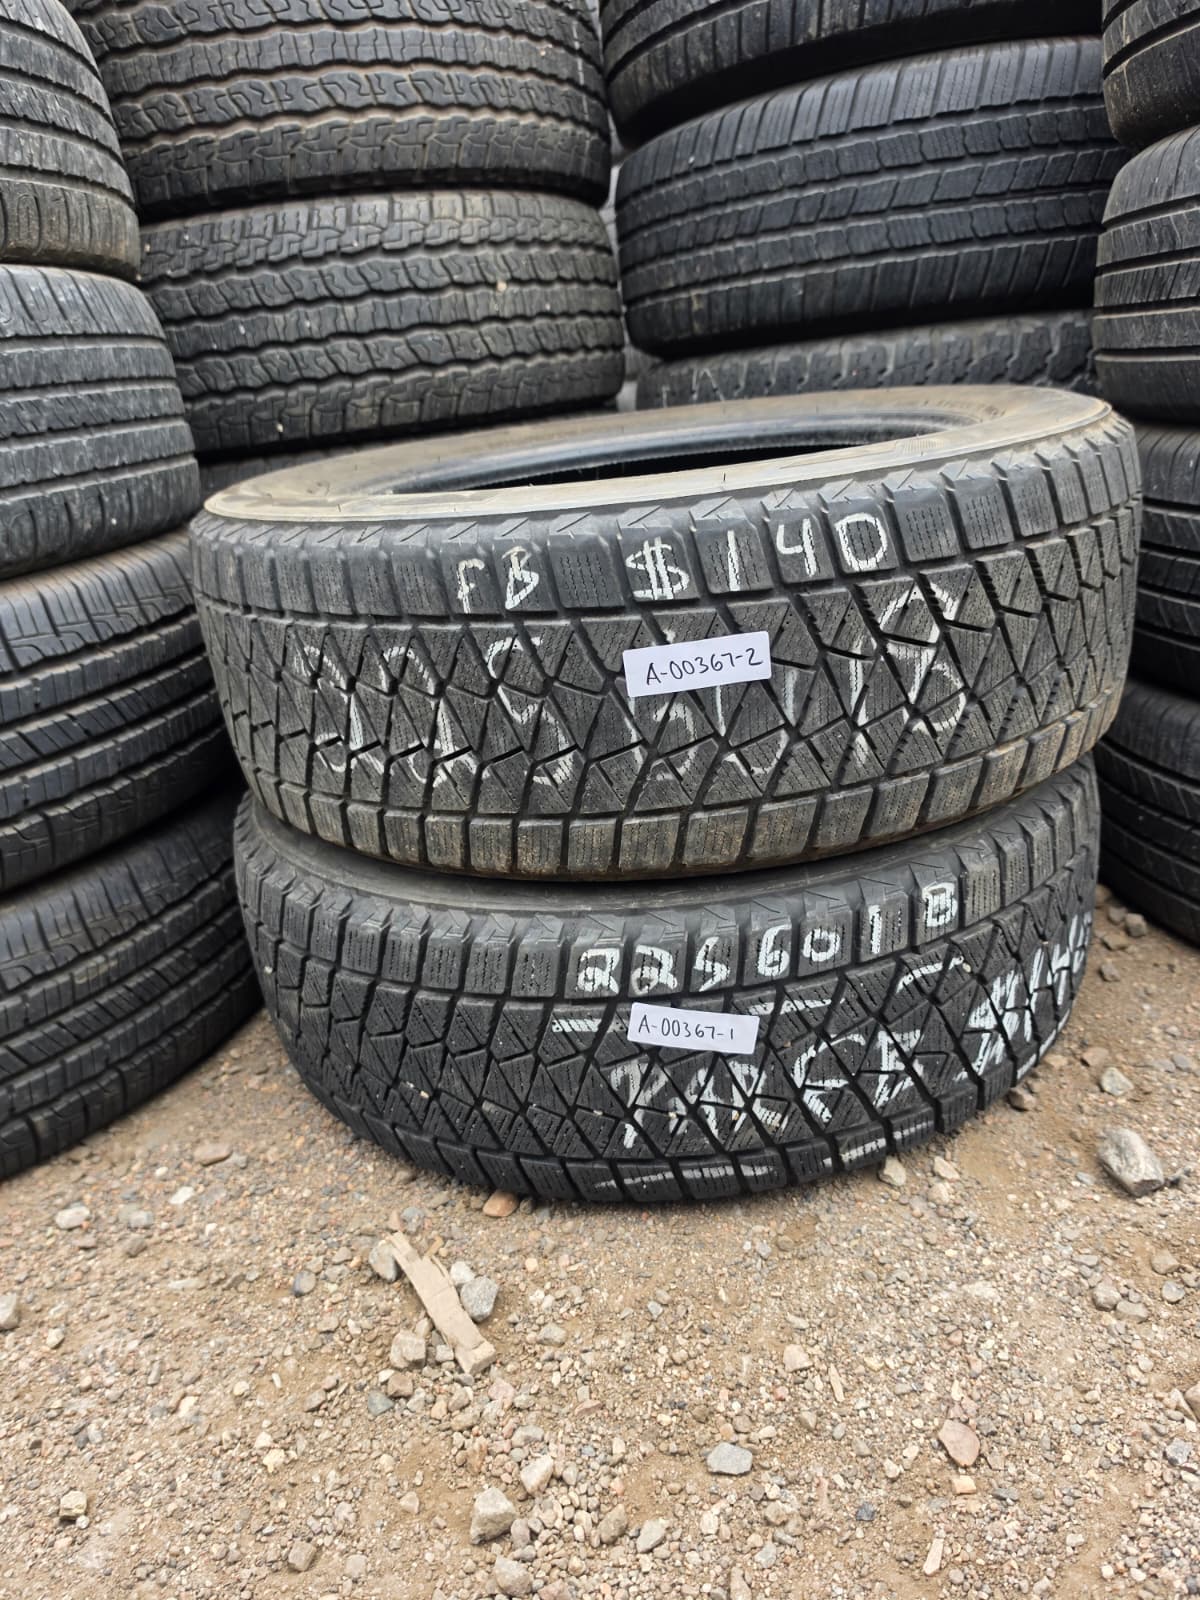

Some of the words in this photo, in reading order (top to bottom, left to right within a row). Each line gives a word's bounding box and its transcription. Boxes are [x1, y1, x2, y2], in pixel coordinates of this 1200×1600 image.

[626, 512, 888, 601] $140
[646, 647, 763, 685] A-00367-2
[638, 1014, 734, 1040] A-00367-1
